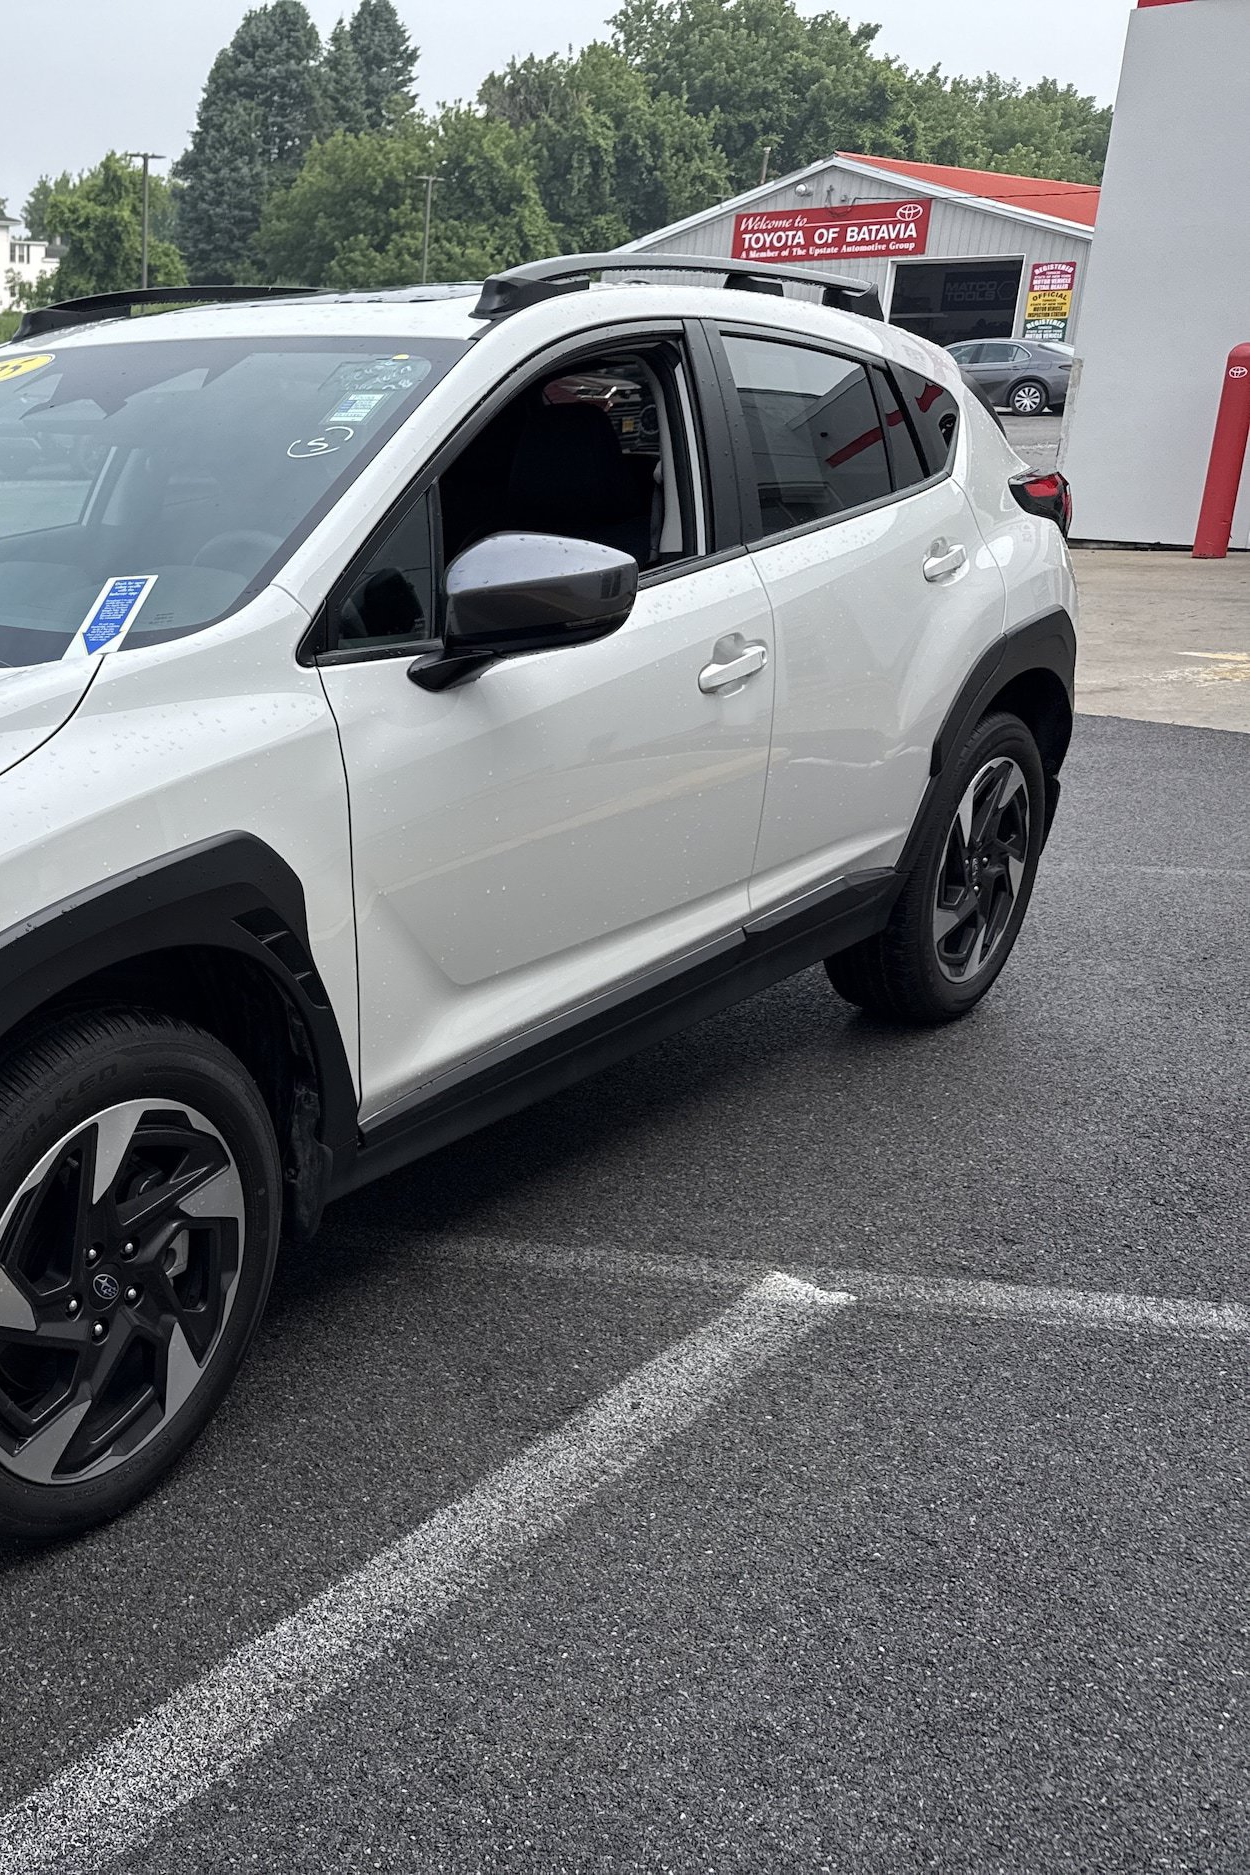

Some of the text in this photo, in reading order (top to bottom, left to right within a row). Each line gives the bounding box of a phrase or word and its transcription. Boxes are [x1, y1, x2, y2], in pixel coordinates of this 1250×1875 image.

[740, 214, 807, 231] Welcome to
[742, 223, 917, 249] TOYOTA OF BATAVIA
[749, 248, 779, 258] Member
[781, 248, 790, 257] of
[792, 247, 806, 256] The
[809, 246, 838, 256] Upstate
[841, 242, 887, 253] Automotive
[889, 241, 915, 251] Group
[1034, 263, 1074, 275] REGISTERED
[946, 281, 997, 293] MATCO
[945, 291, 996, 301] TOOLS
[1032, 292, 1067, 301] OFFICIAL
[1026, 319, 1065, 329] REGISTERED
